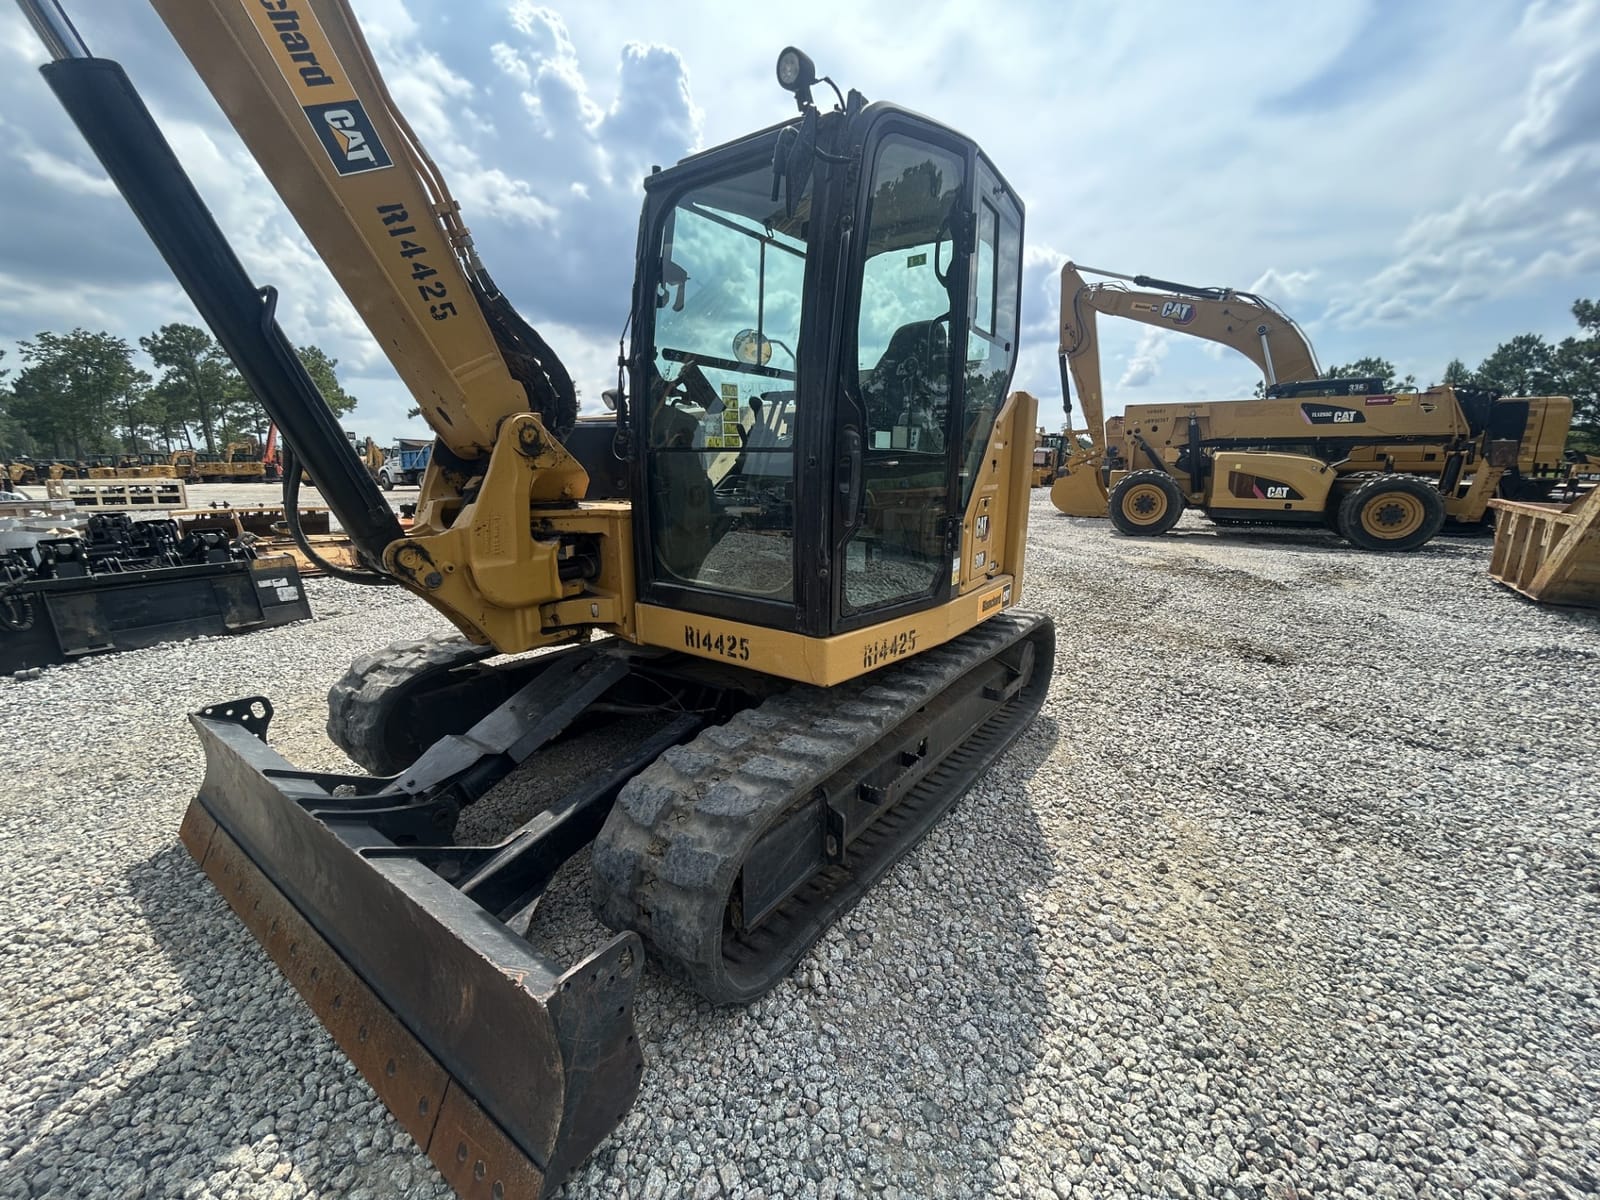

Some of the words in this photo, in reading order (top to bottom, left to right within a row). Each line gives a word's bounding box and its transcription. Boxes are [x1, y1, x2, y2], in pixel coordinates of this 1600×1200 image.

[324, 109, 376, 162] CAT
[1161, 301, 1191, 320] CAT
[1333, 411, 1356, 423] CAT
[1267, 486, 1289, 498] CAT
